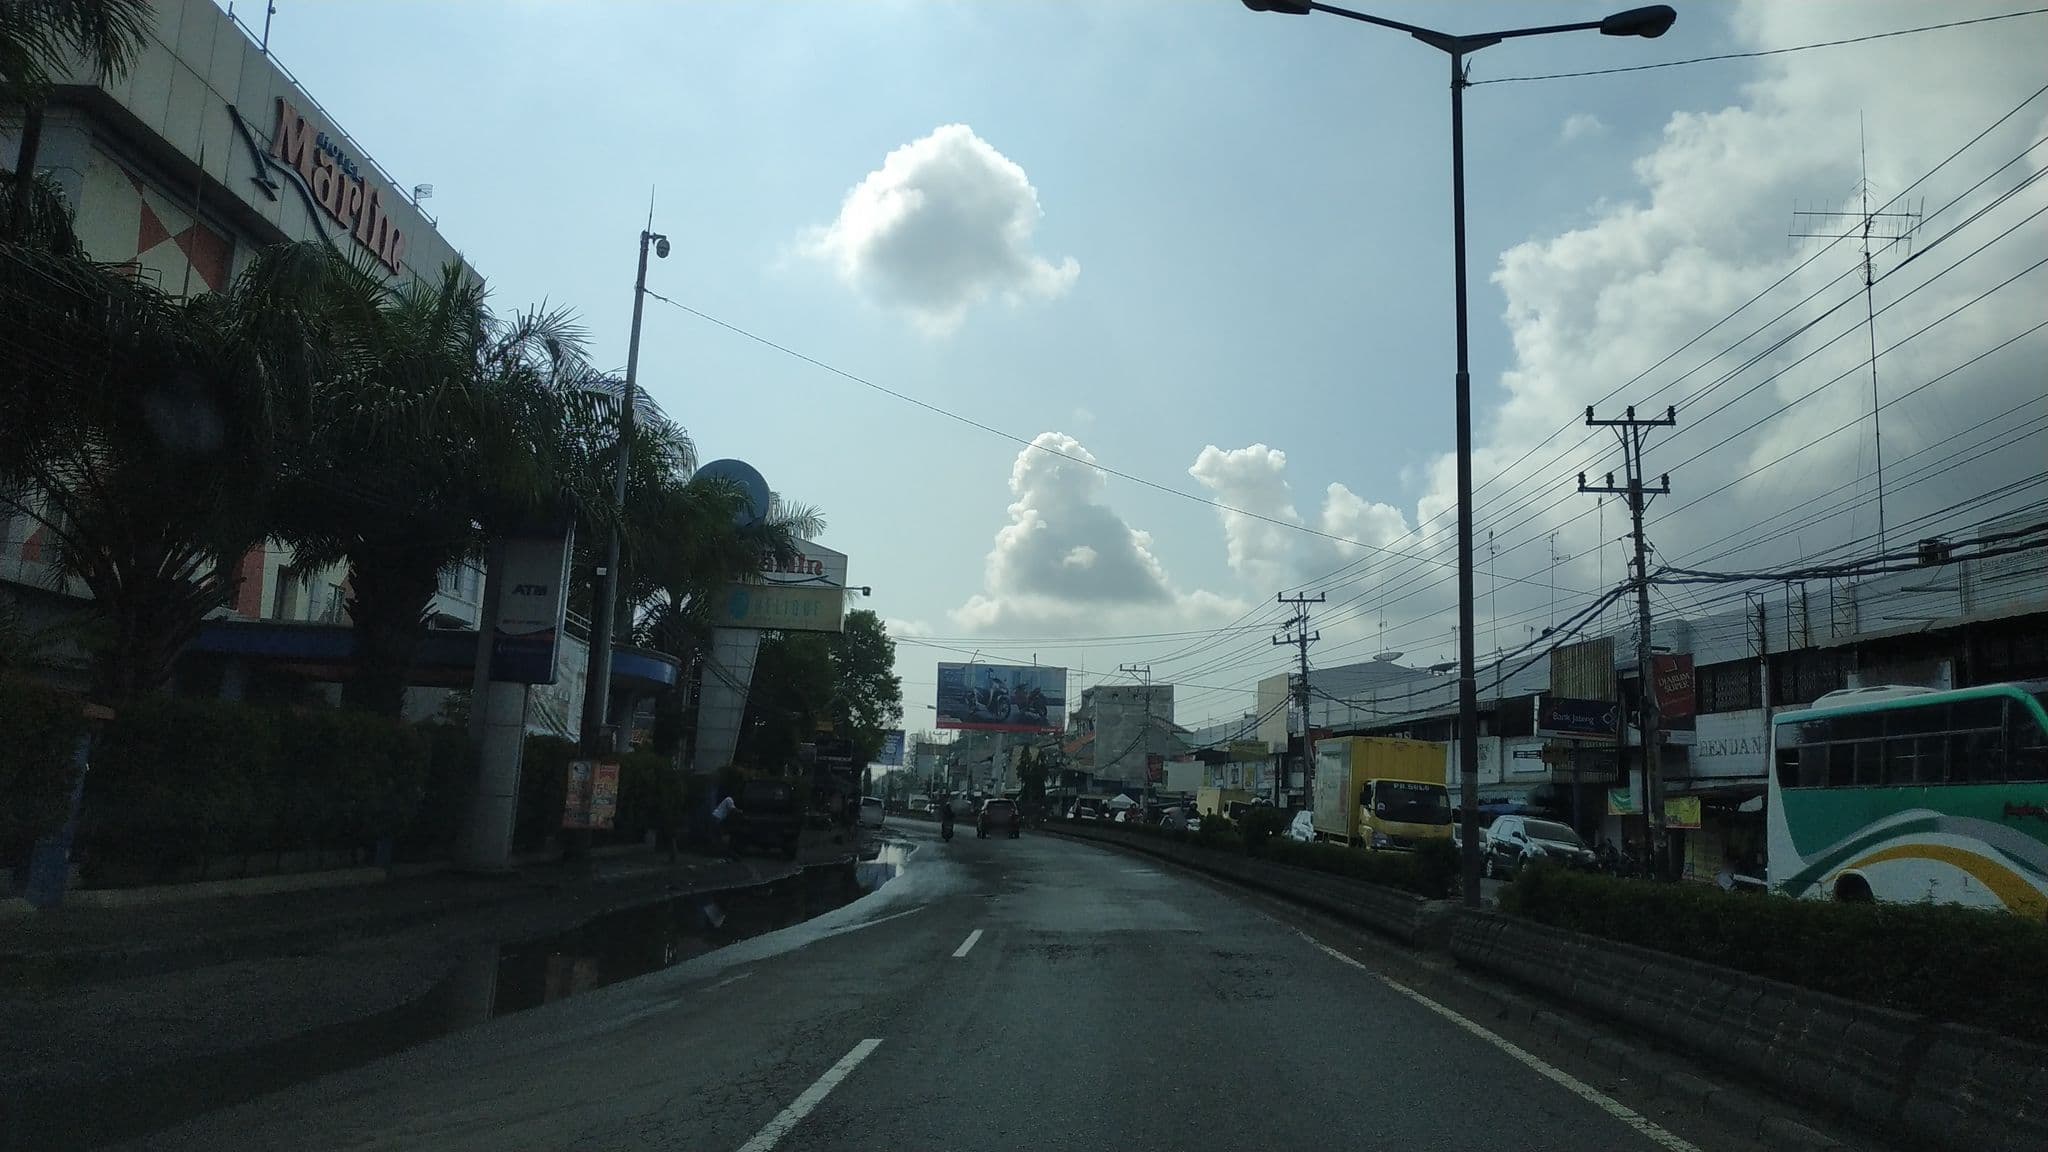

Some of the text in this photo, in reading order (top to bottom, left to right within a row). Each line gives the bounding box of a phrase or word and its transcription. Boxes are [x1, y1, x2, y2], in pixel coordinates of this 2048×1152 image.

[269, 96, 405, 275] Marlin
[511, 584, 547, 596] ATM
[1552, 711, 1570, 721] Bank
